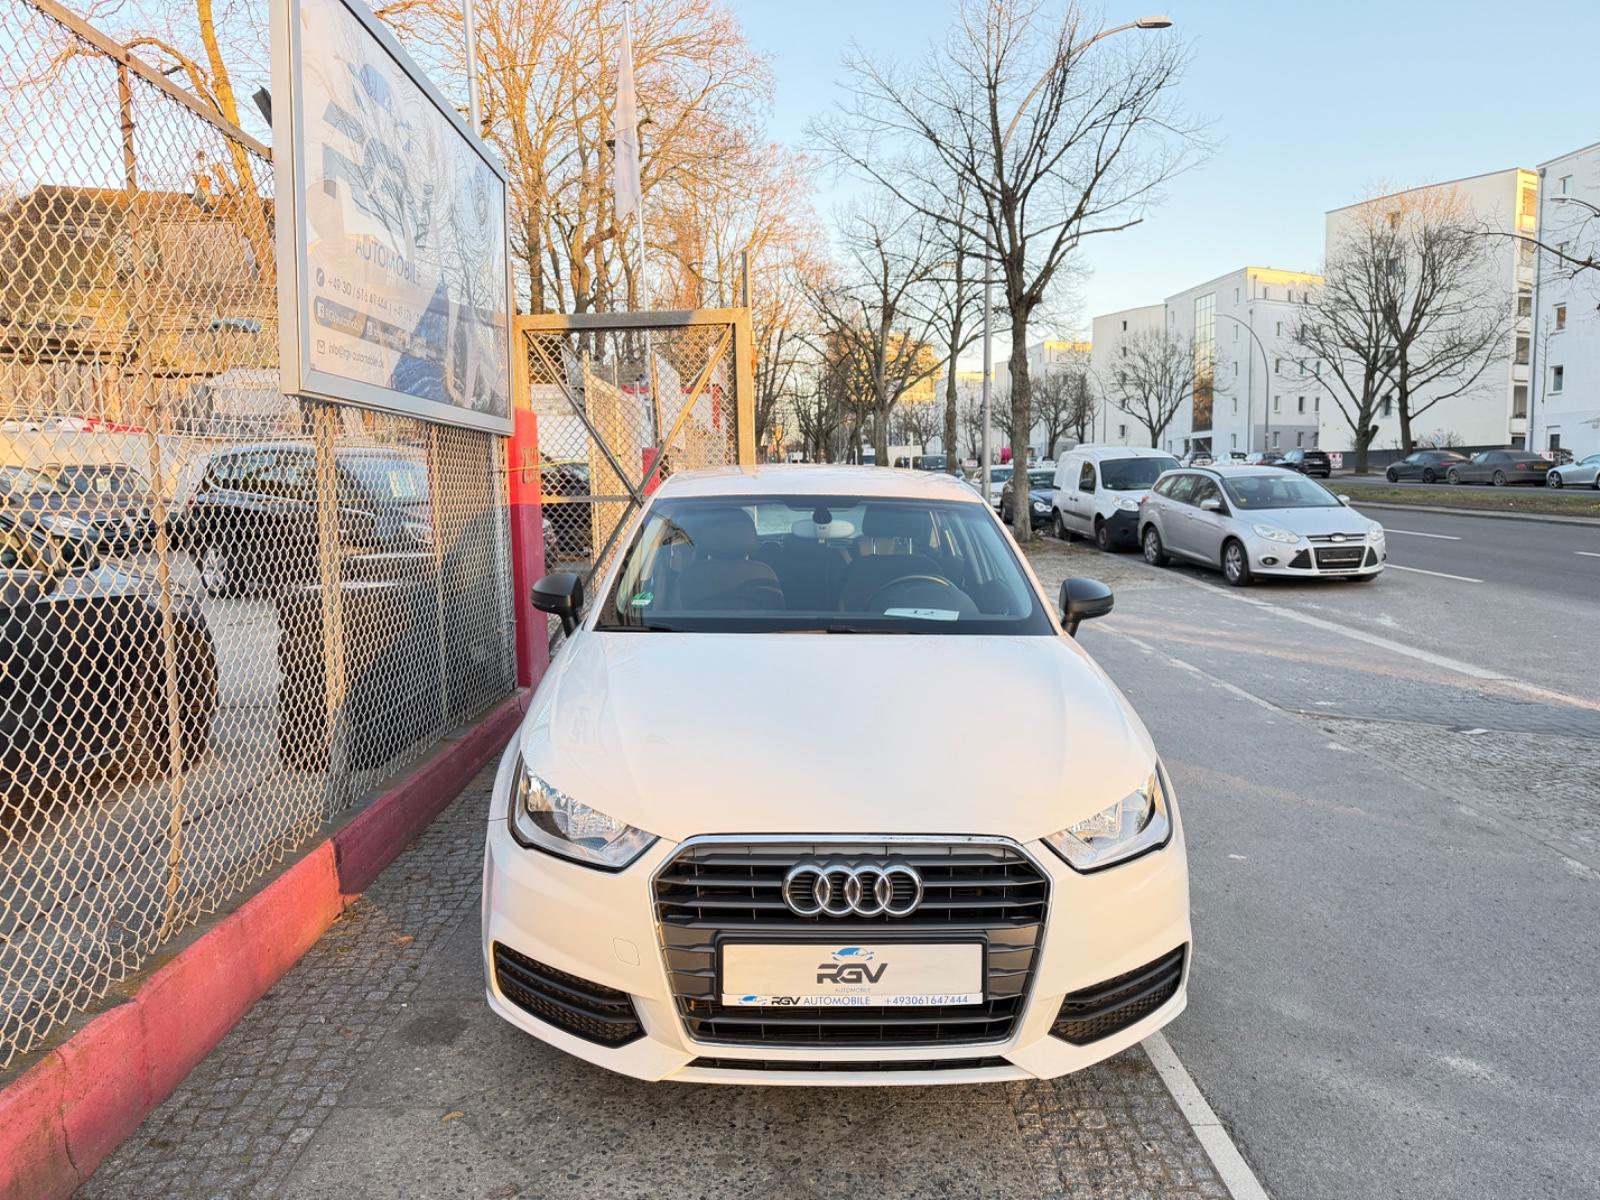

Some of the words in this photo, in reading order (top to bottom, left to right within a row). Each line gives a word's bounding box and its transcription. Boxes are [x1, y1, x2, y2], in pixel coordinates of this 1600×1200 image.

[816, 963, 888, 985] RGV
[771, 996, 801, 1006] RGV
[803, 996, 871, 1006] AUTOMOBILE
[885, 995, 968, 1005] +493061647444
